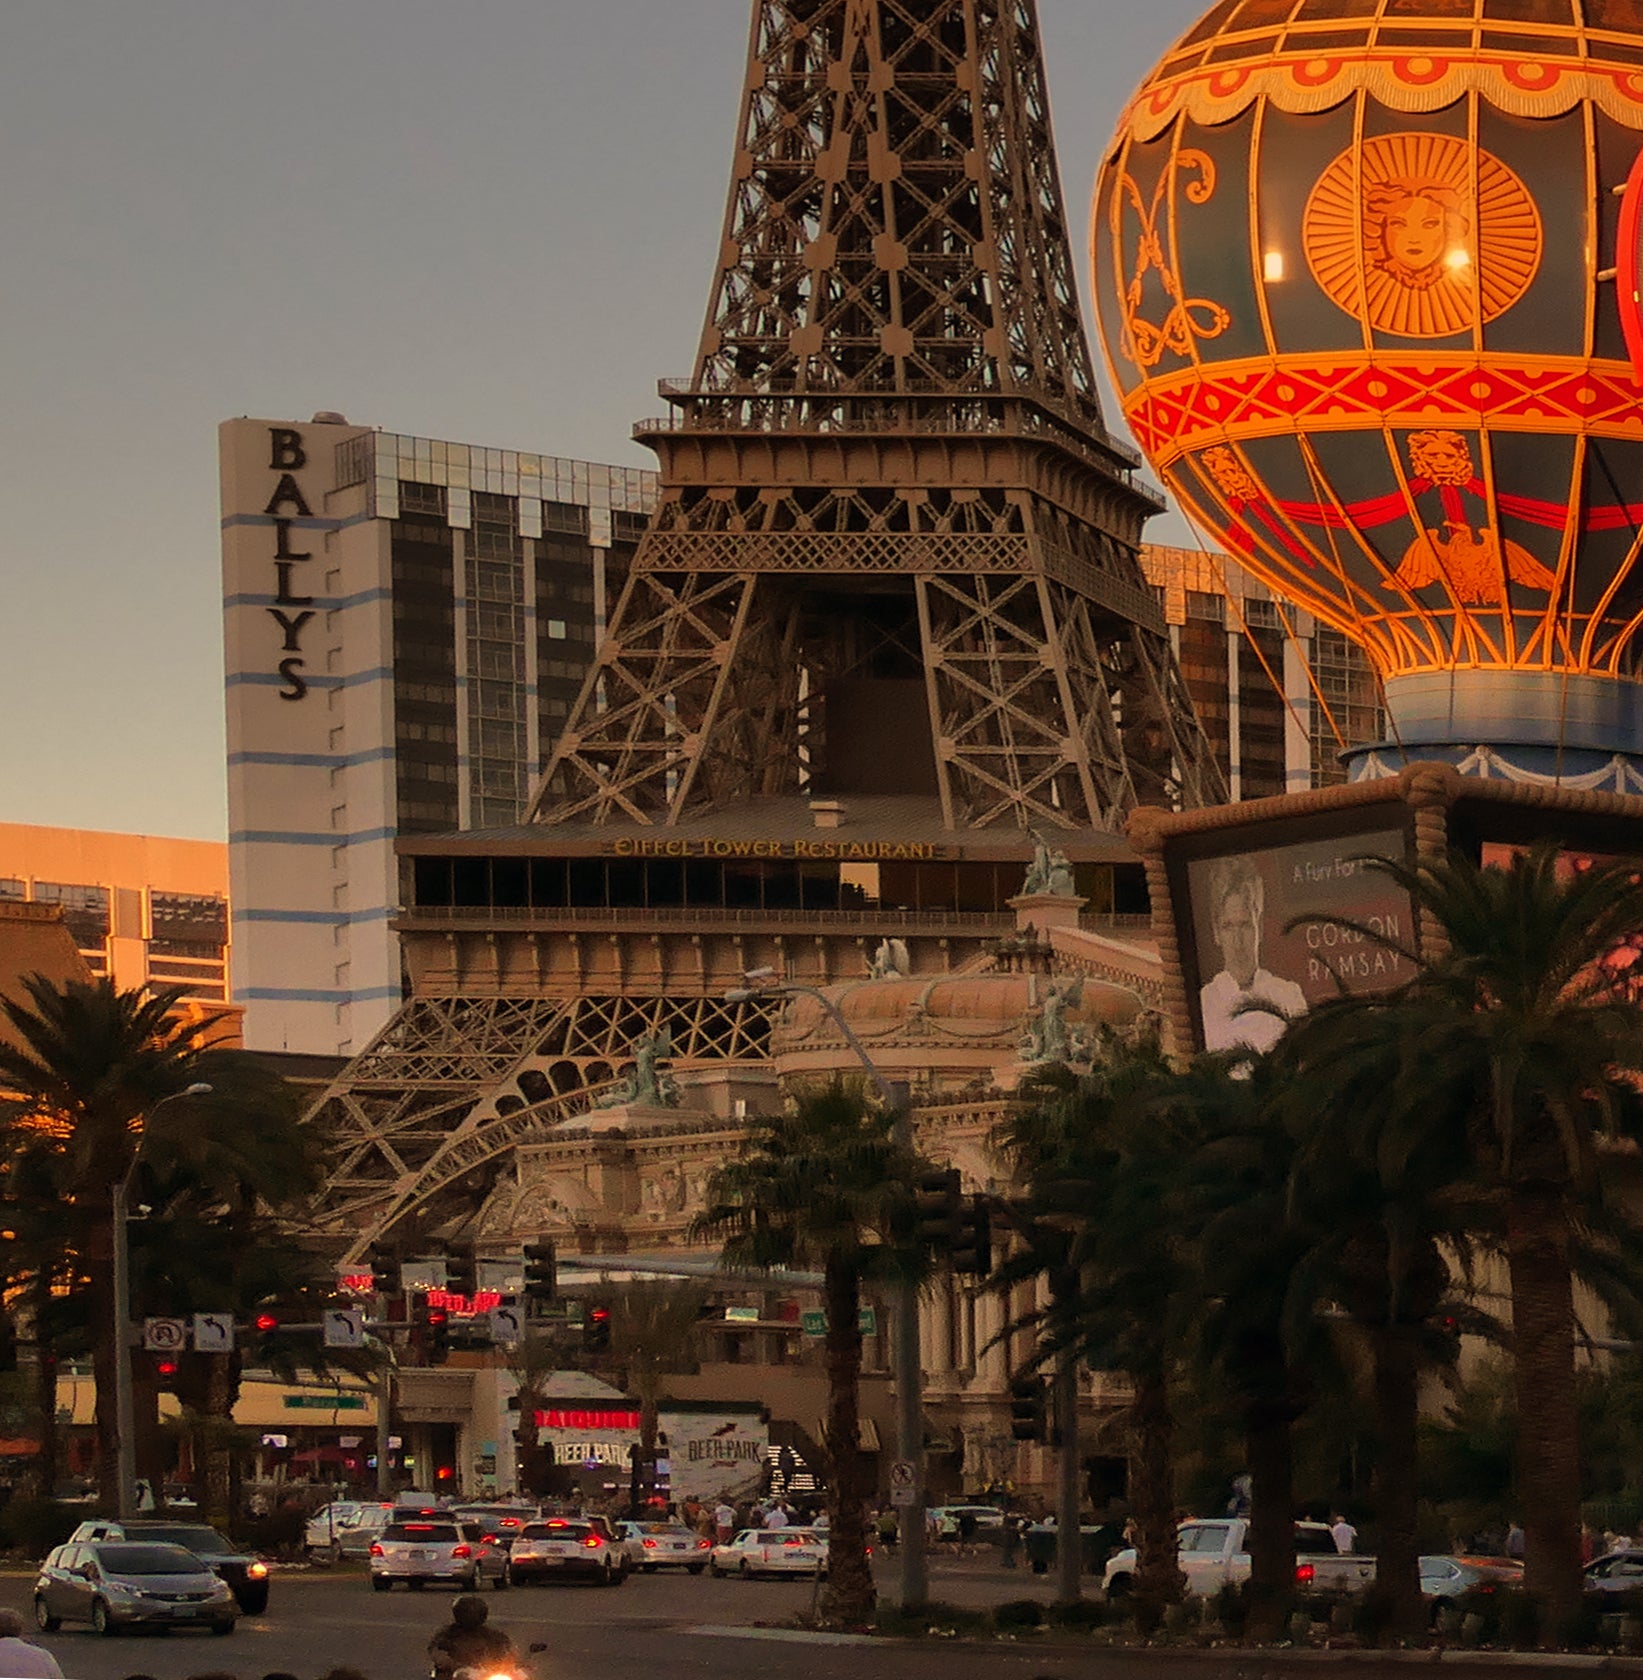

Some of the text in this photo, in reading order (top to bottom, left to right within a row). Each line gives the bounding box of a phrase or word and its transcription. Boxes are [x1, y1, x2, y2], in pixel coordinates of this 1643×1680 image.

[264, 427, 315, 703] BALLYS
[615, 837, 937, 859] EIFFEL TOWER RESTAURANT
